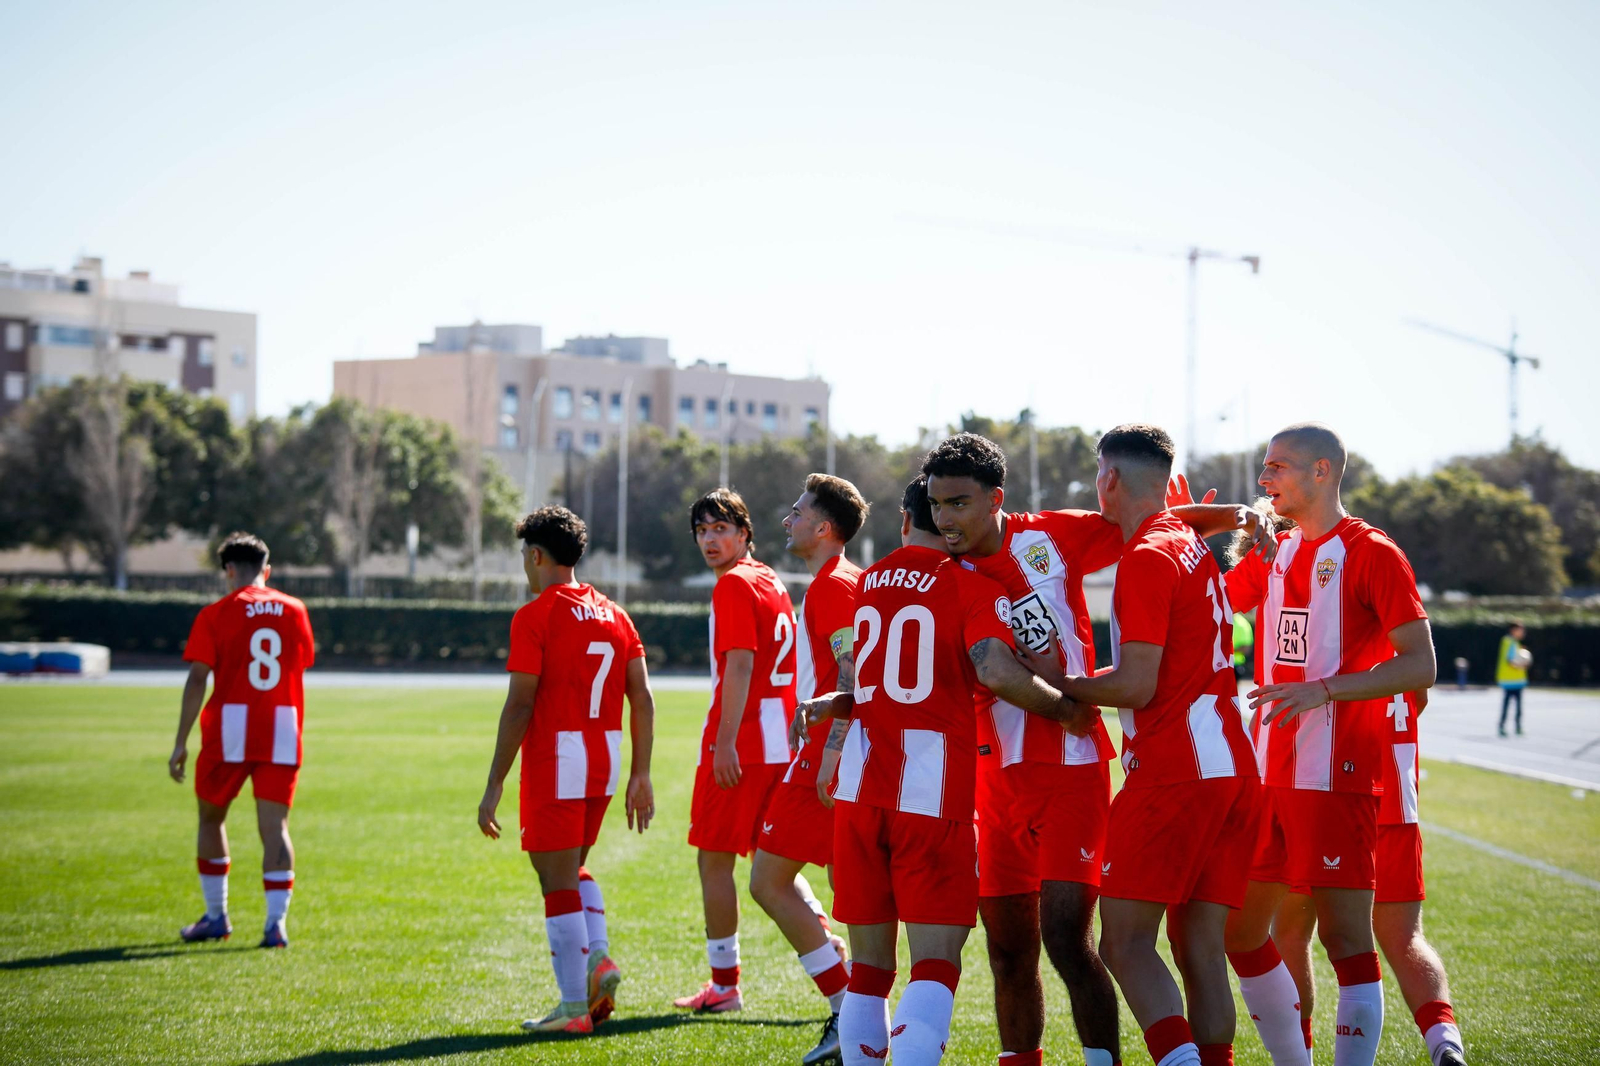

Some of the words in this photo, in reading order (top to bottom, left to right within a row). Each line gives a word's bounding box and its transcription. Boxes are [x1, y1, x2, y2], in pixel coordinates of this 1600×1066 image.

[863, 568, 937, 593] MARSU
[245, 601, 284, 618] JOAN
[571, 604, 615, 623] VALEN
[1018, 623, 1047, 645] ZN
[1284, 619, 1299, 635] DA
[769, 611, 797, 687] 2
[853, 604, 935, 704] 20
[1283, 639, 1298, 654] ZN
[248, 627, 282, 692] 8
[586, 641, 615, 719] 7
